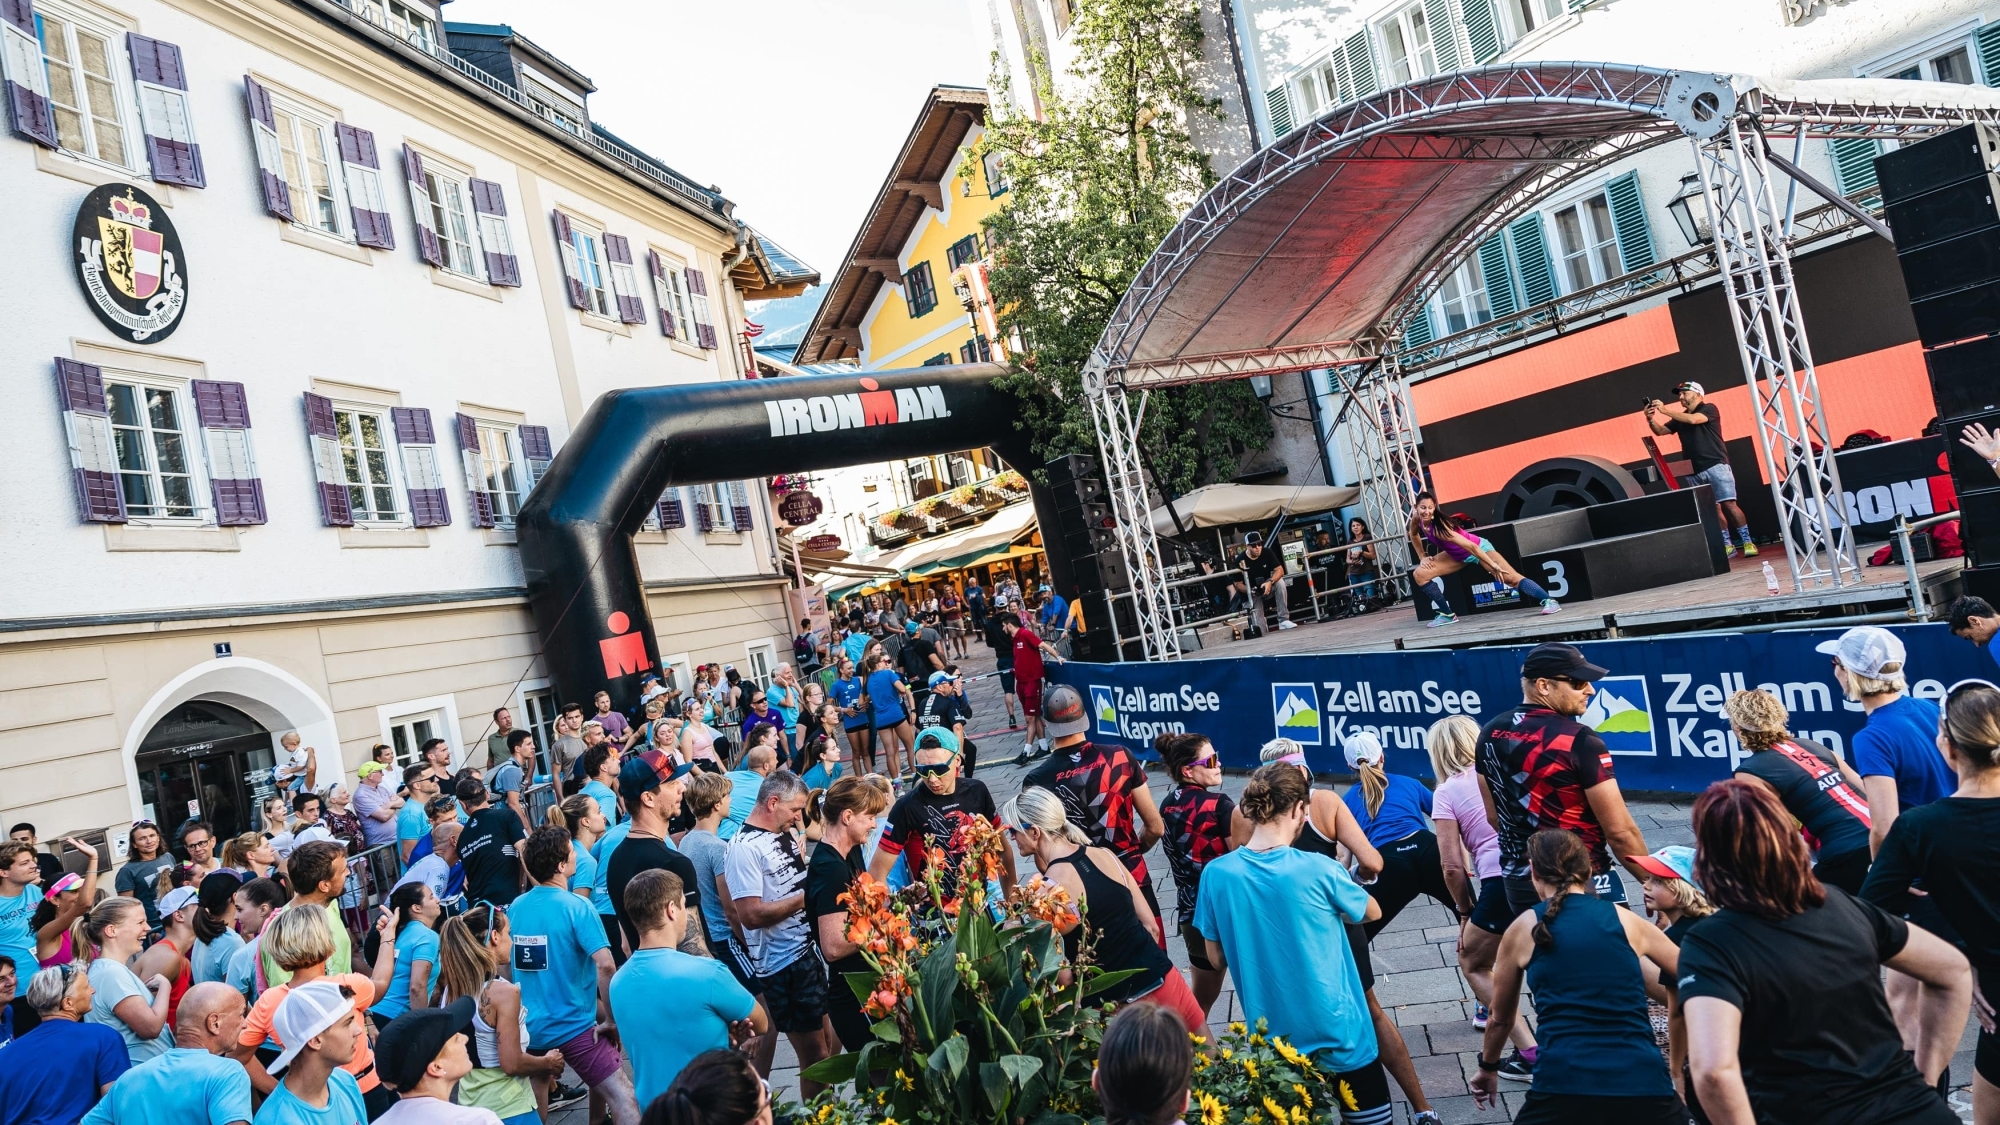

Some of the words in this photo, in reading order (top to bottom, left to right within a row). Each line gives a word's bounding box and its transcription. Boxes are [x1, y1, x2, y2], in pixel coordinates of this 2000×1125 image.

[764, 377, 947, 438] IRONMAN
[788, 500, 812, 510] CELLA
[783, 507, 820, 519] CENTRAL
[1542, 560, 1569, 598] 3
[1474, 592, 1492, 604] 70.3
[220, 644, 227, 653] 1
[1114, 686, 1147, 712] Zell
[1149, 692, 1179, 712] am
[1180, 684, 1220, 712] See
[1323, 681, 1375, 712] Zell
[1378, 690, 1421, 713] am
[1421, 680, 1482, 714] See
[163, 722, 186, 735] Land
[187, 719, 220, 732] Salzburg
[1817, 772, 1842, 791] AUT
[1594, 874, 1611, 889] 22
[523, 947, 531, 959] 5
